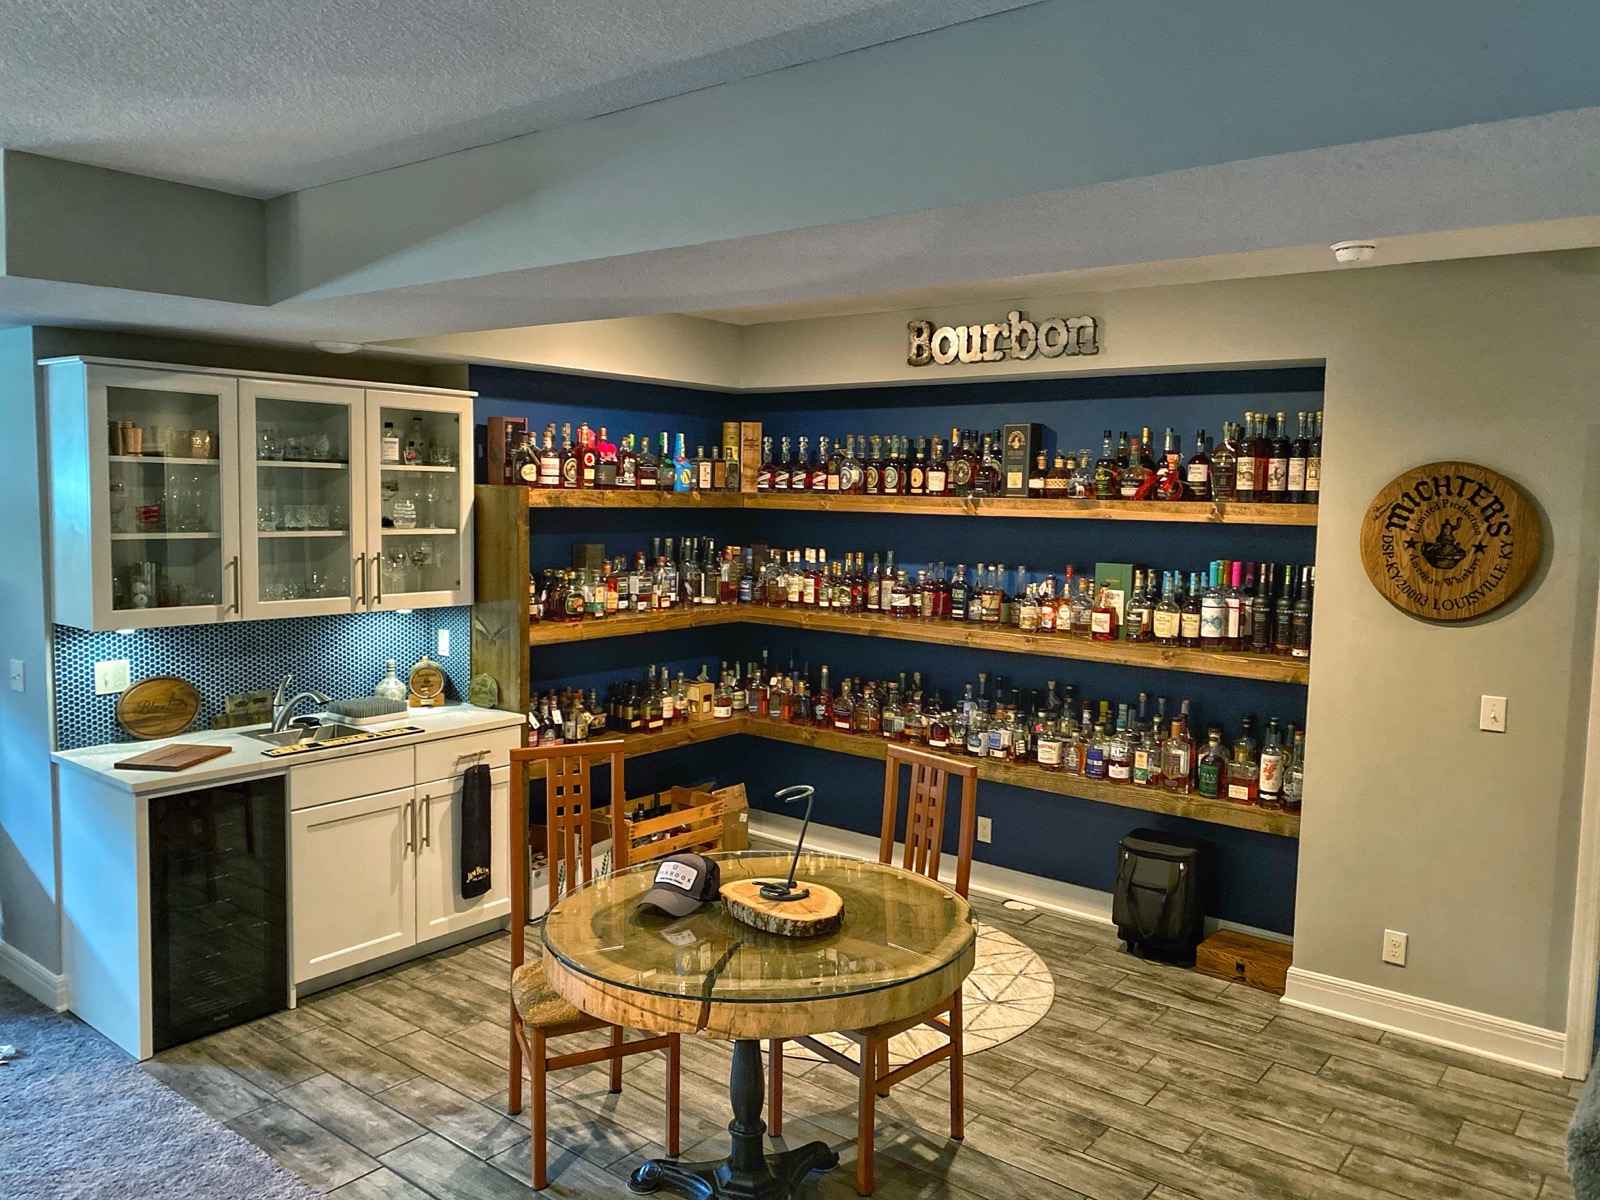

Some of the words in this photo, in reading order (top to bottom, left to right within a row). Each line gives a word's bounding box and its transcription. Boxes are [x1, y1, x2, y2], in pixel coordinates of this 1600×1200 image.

[907, 310, 1100, 367] Bourbon
[1385, 474, 1514, 537] MICHTER'S
[1409, 502, 1440, 533] Limited
[1442, 499, 1481, 535] Production
[1382, 534, 1429, 607] DSP-KY-20003
[1500, 540, 1514, 561] KY
[1409, 554, 1440, 586] American
[1443, 558, 1480, 587] Whiskey
